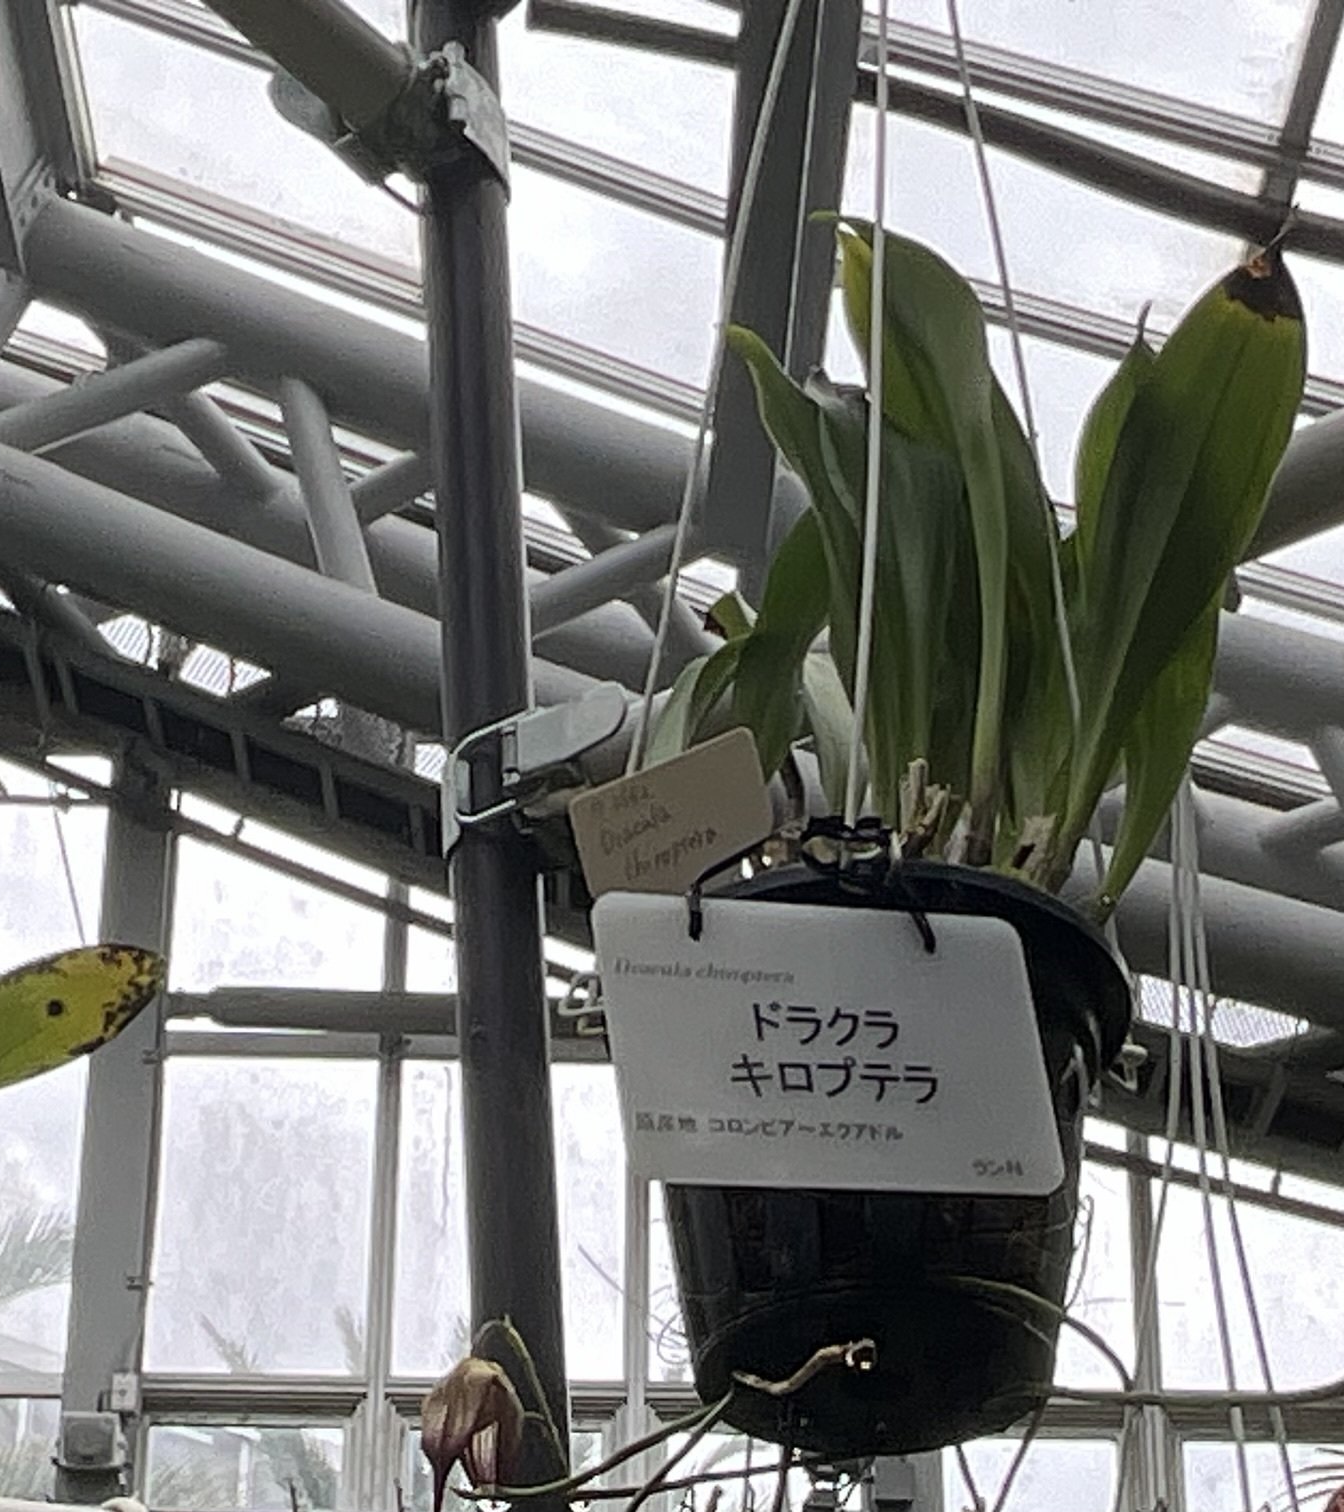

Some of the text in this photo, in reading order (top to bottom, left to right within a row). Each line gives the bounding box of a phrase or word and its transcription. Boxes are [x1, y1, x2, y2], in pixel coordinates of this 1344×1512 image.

[752, 1001, 899, 1049] ドラクラ
[731, 1053, 938, 1104] キロプテラ
